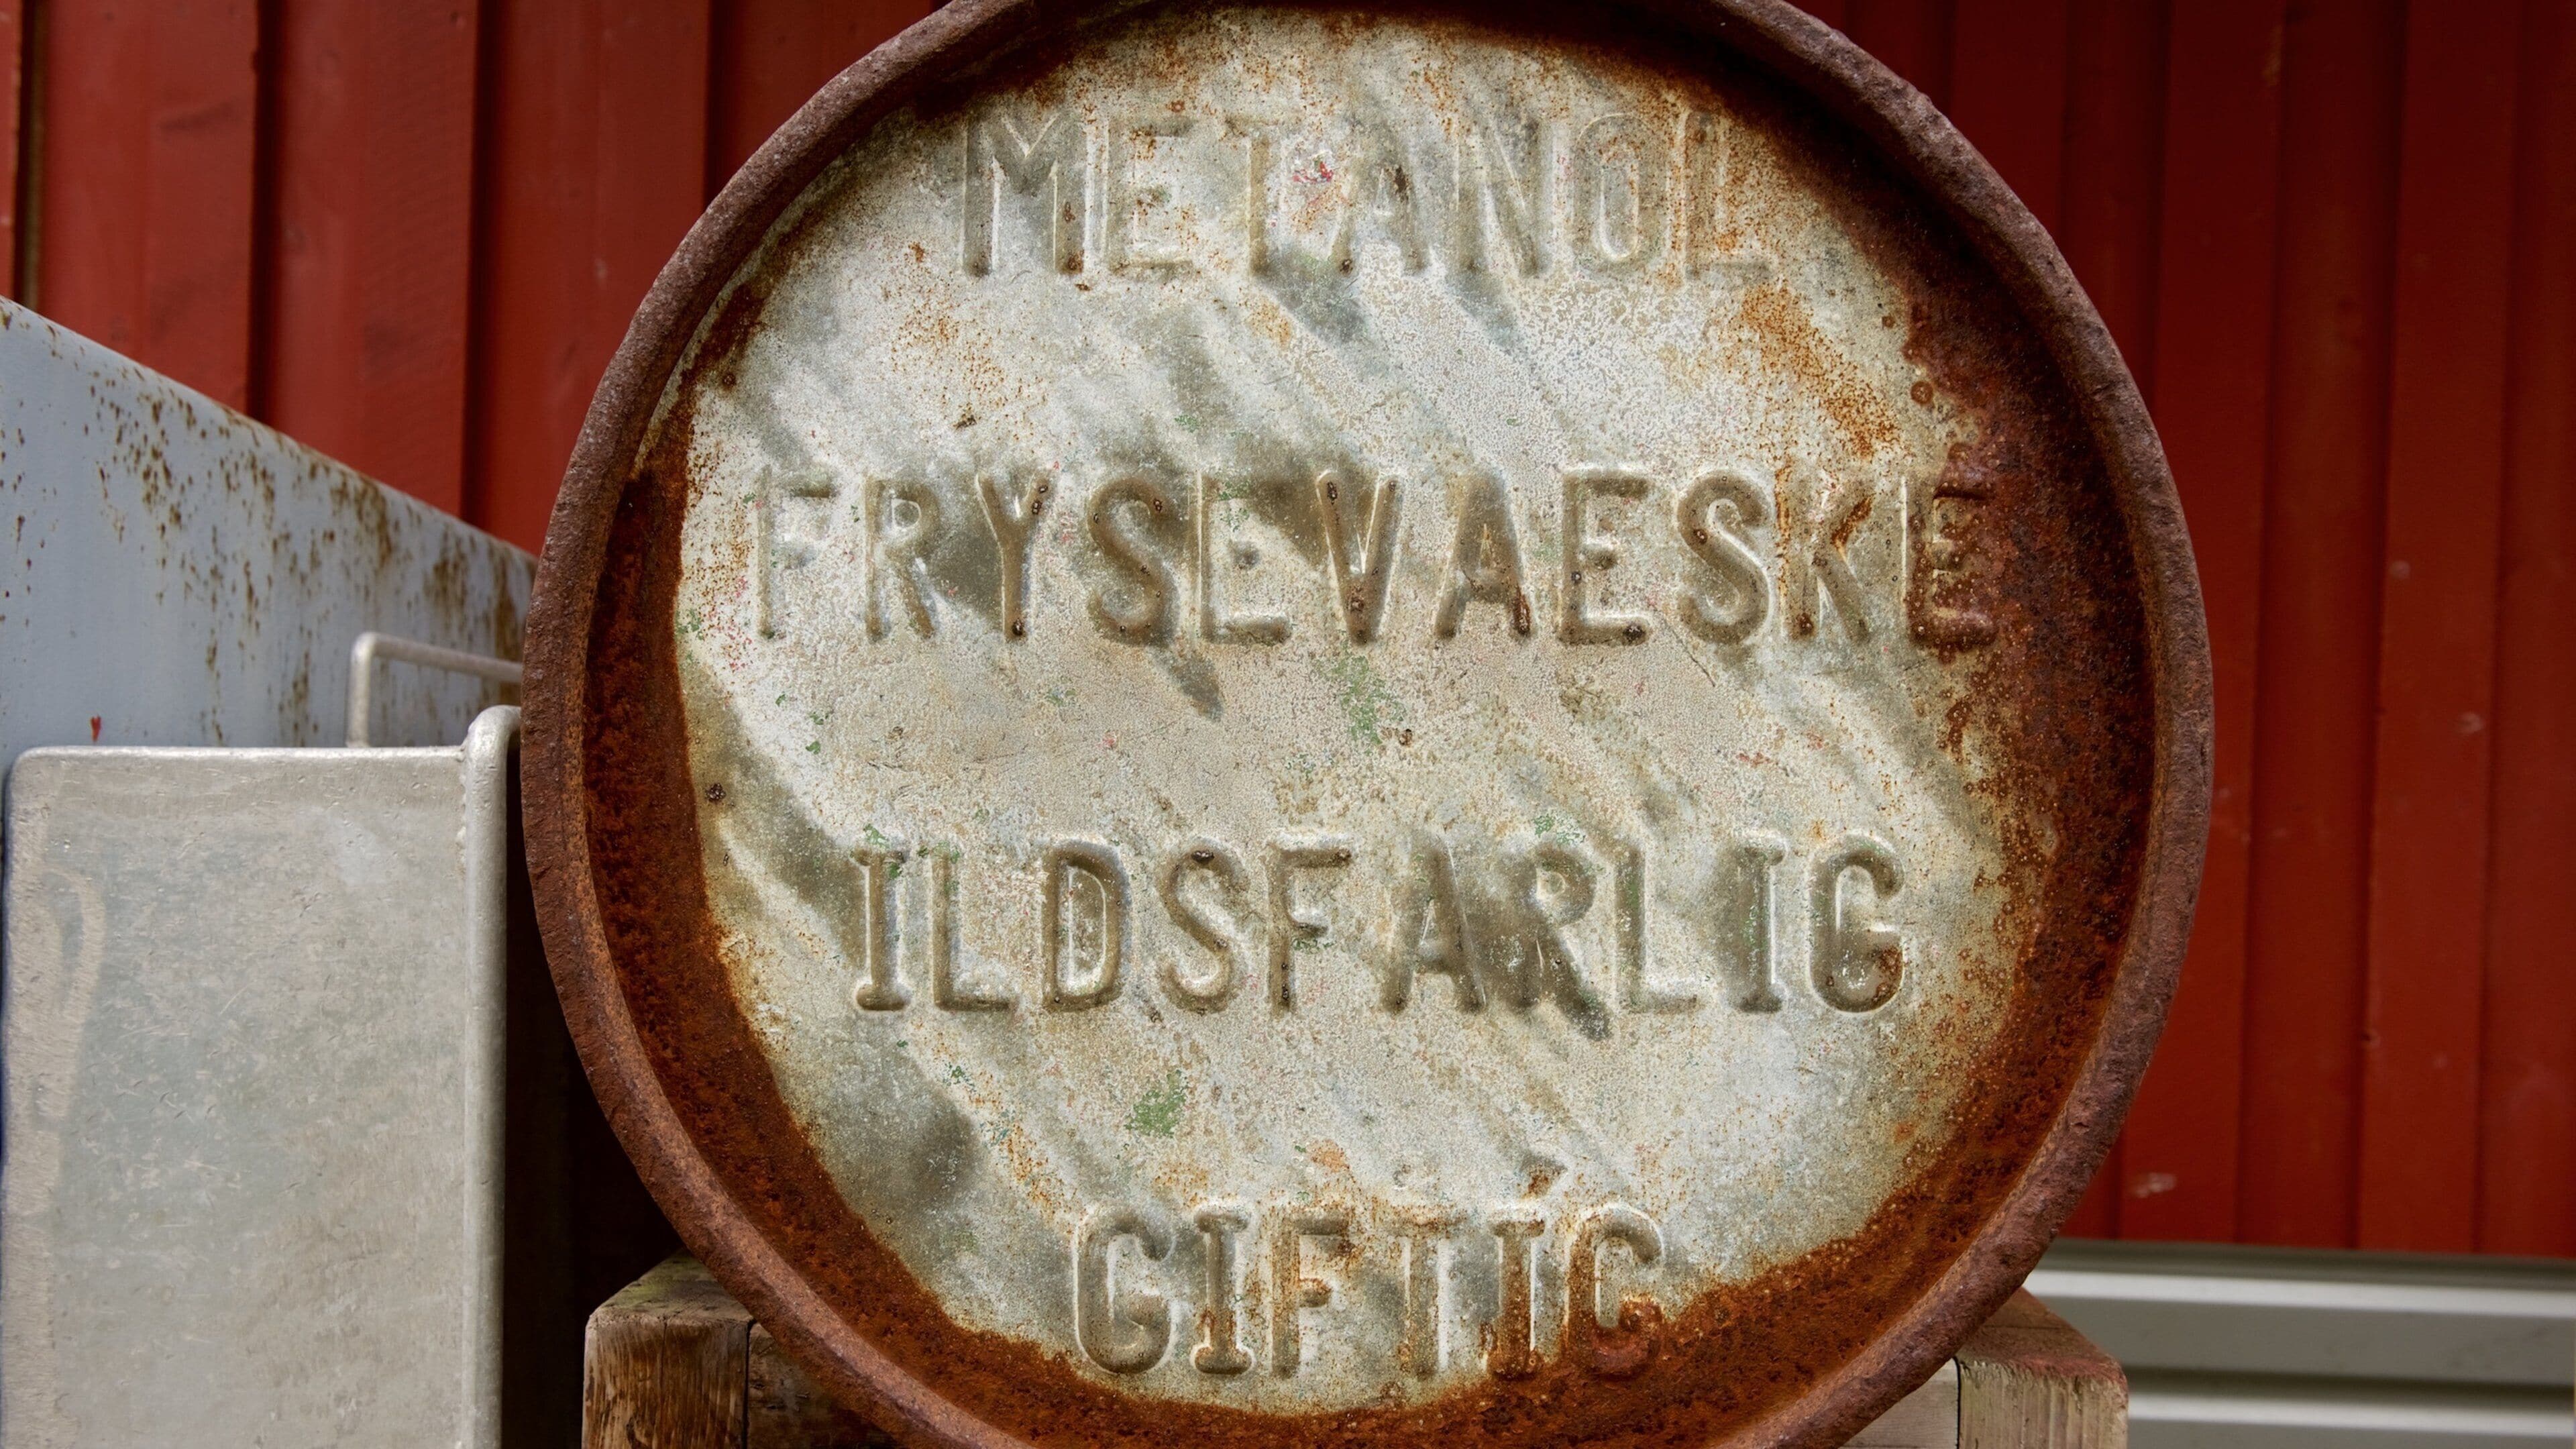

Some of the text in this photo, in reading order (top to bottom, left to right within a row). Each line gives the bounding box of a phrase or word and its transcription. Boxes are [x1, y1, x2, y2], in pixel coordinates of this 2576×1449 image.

[962, 111, 1771, 279] METANOL
[755, 468, 1998, 647] FRYSEVAESKE
[851, 836, 1907, 1016] ILDSFARLIG
[1075, 1210, 1665, 1378] GIFTIG
